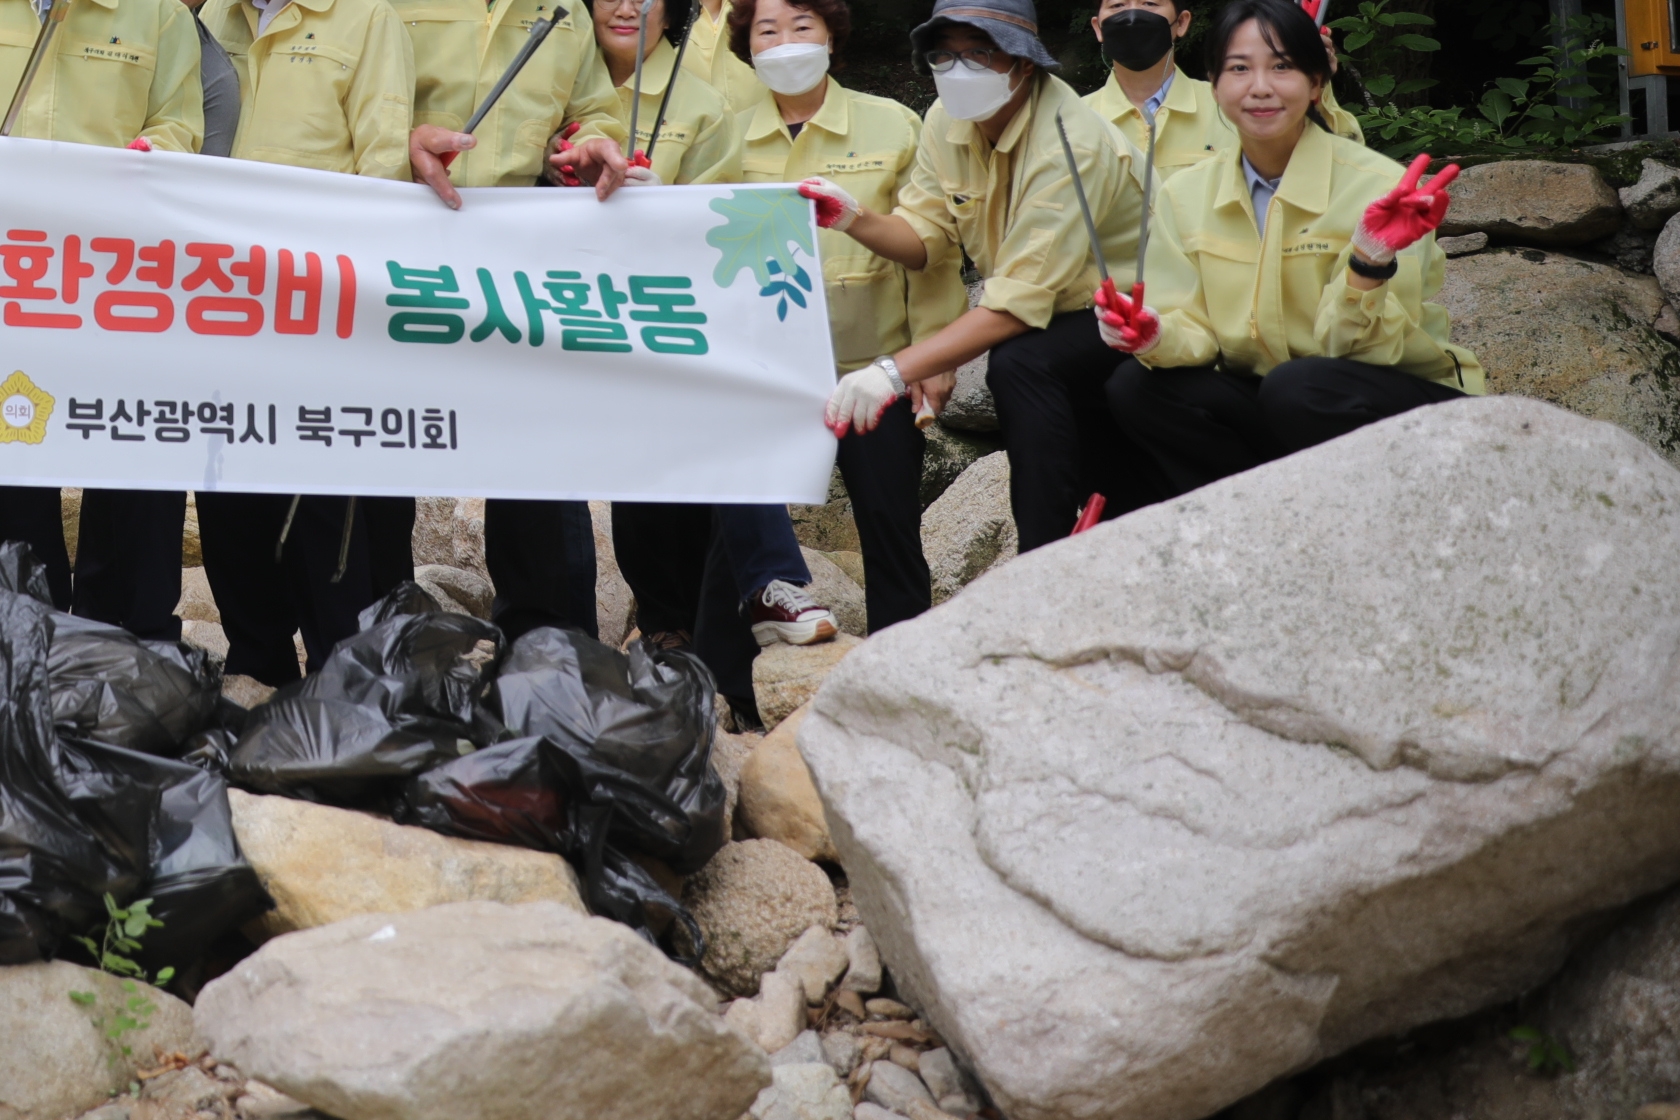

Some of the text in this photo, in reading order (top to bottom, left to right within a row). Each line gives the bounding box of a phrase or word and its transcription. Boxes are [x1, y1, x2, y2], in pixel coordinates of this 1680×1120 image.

[385, 260, 709, 356] 봉사활동
[5, 404, 31, 420] 의회
[65, 397, 458, 450] 부산광역시 북구의회
